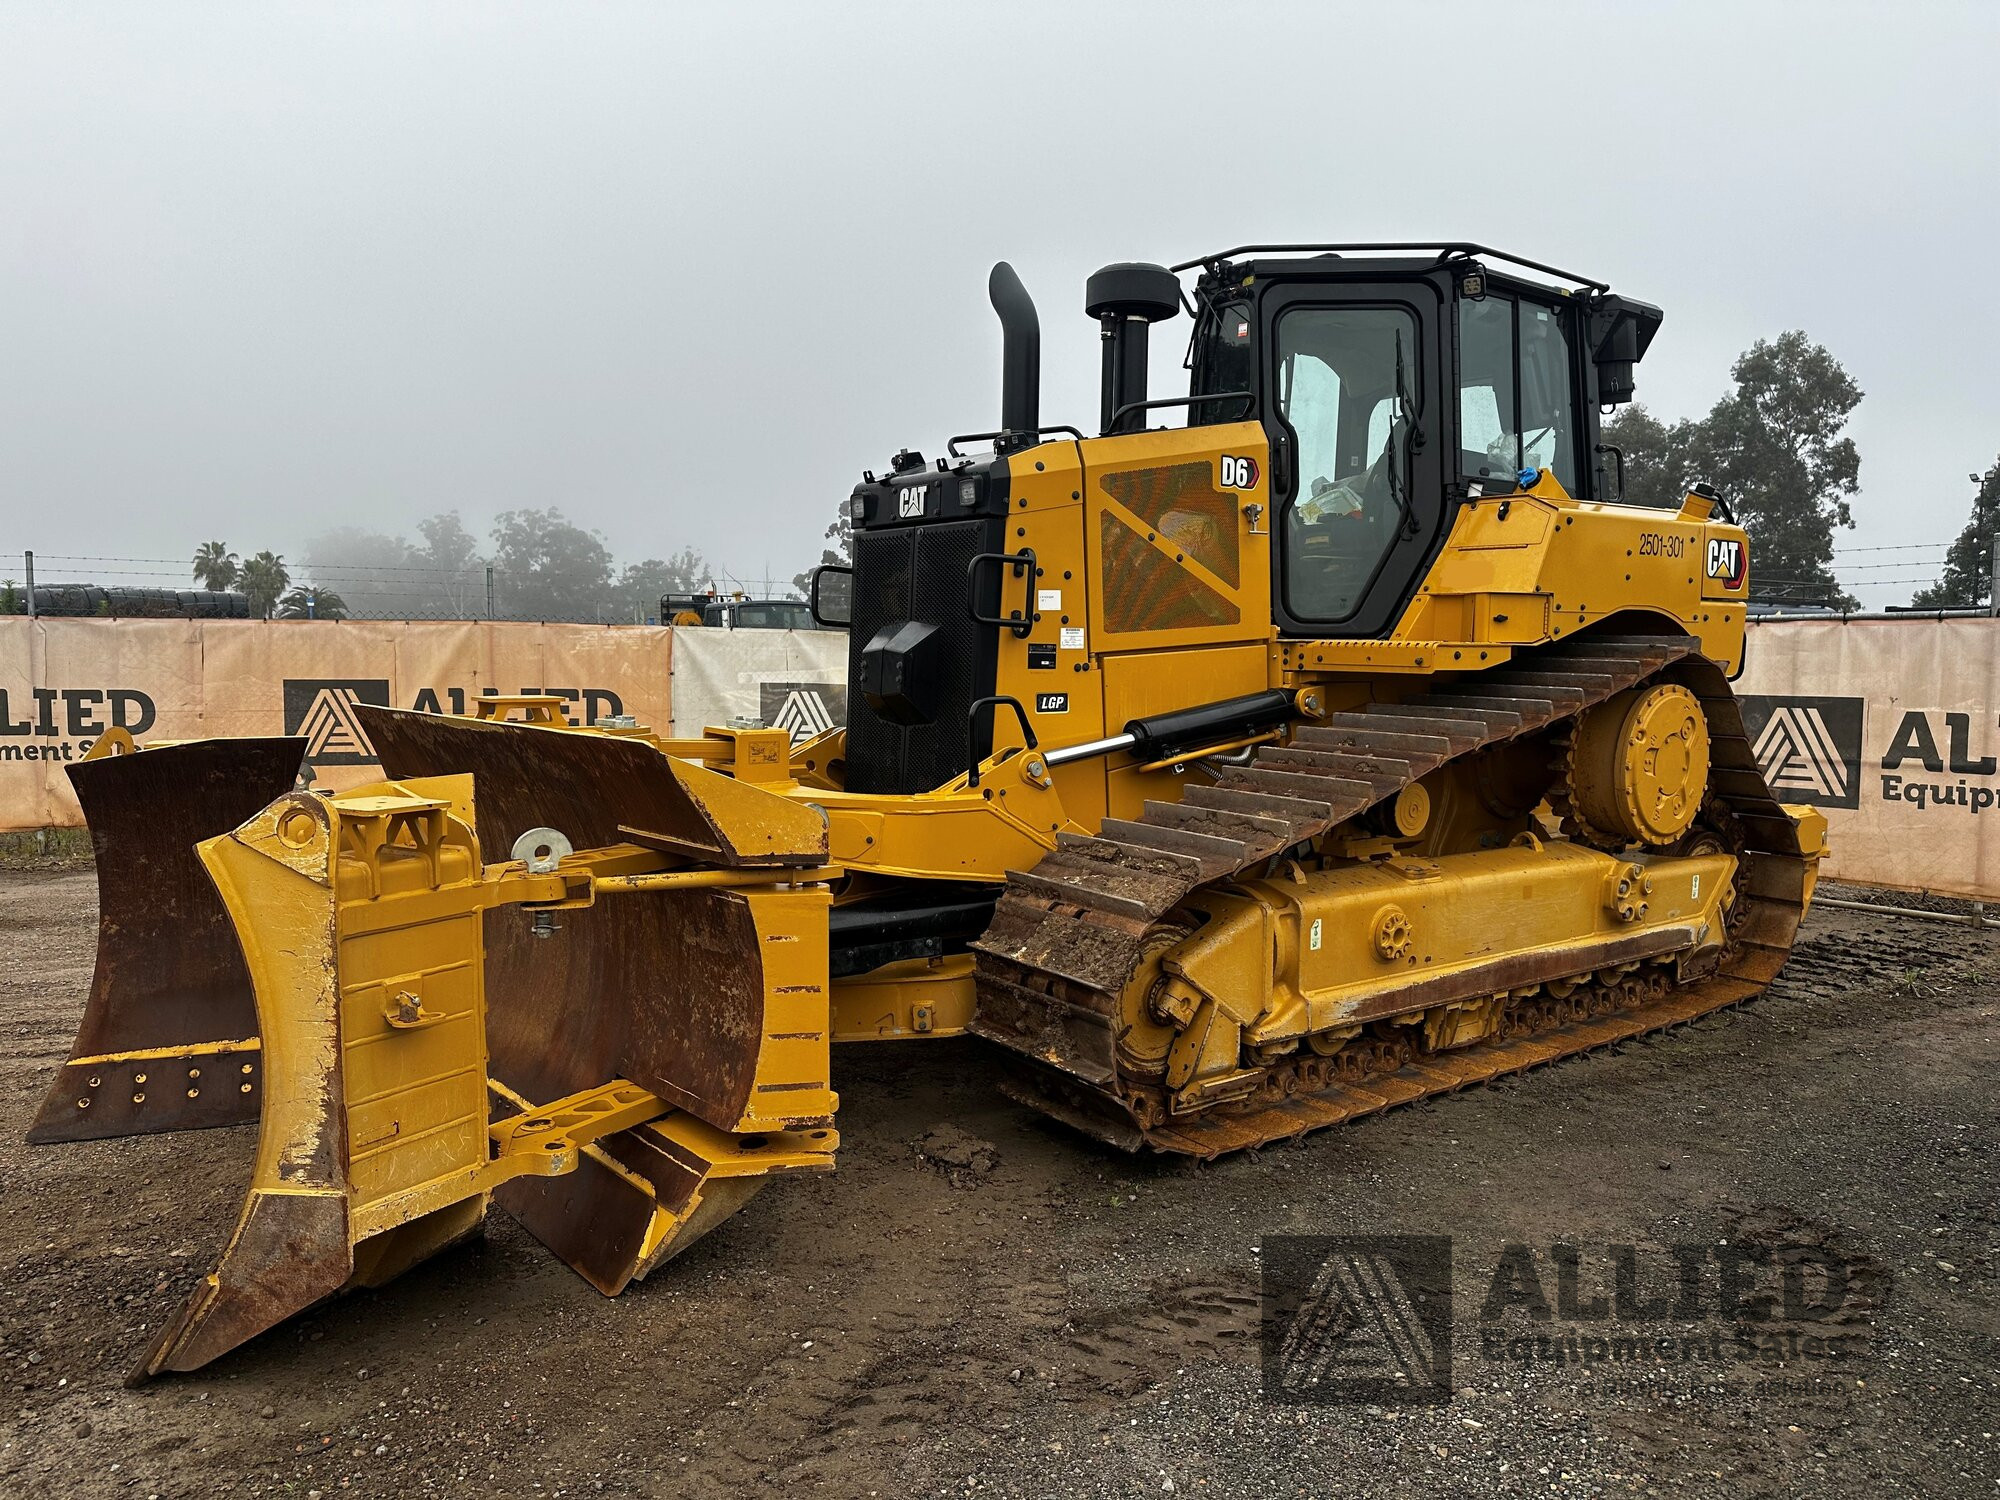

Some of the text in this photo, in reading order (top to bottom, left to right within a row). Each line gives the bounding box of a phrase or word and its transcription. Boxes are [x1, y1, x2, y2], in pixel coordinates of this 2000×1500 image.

[1222, 456, 1248, 487] D6
[900, 485, 928, 518] CAT
[1639, 533, 1685, 559] 2501-301
[1707, 539, 1739, 578] CAT
[1041, 696, 1064, 710] LGP
[1881, 711, 2000, 776] AL
[1881, 774, 2000, 814] Equip
